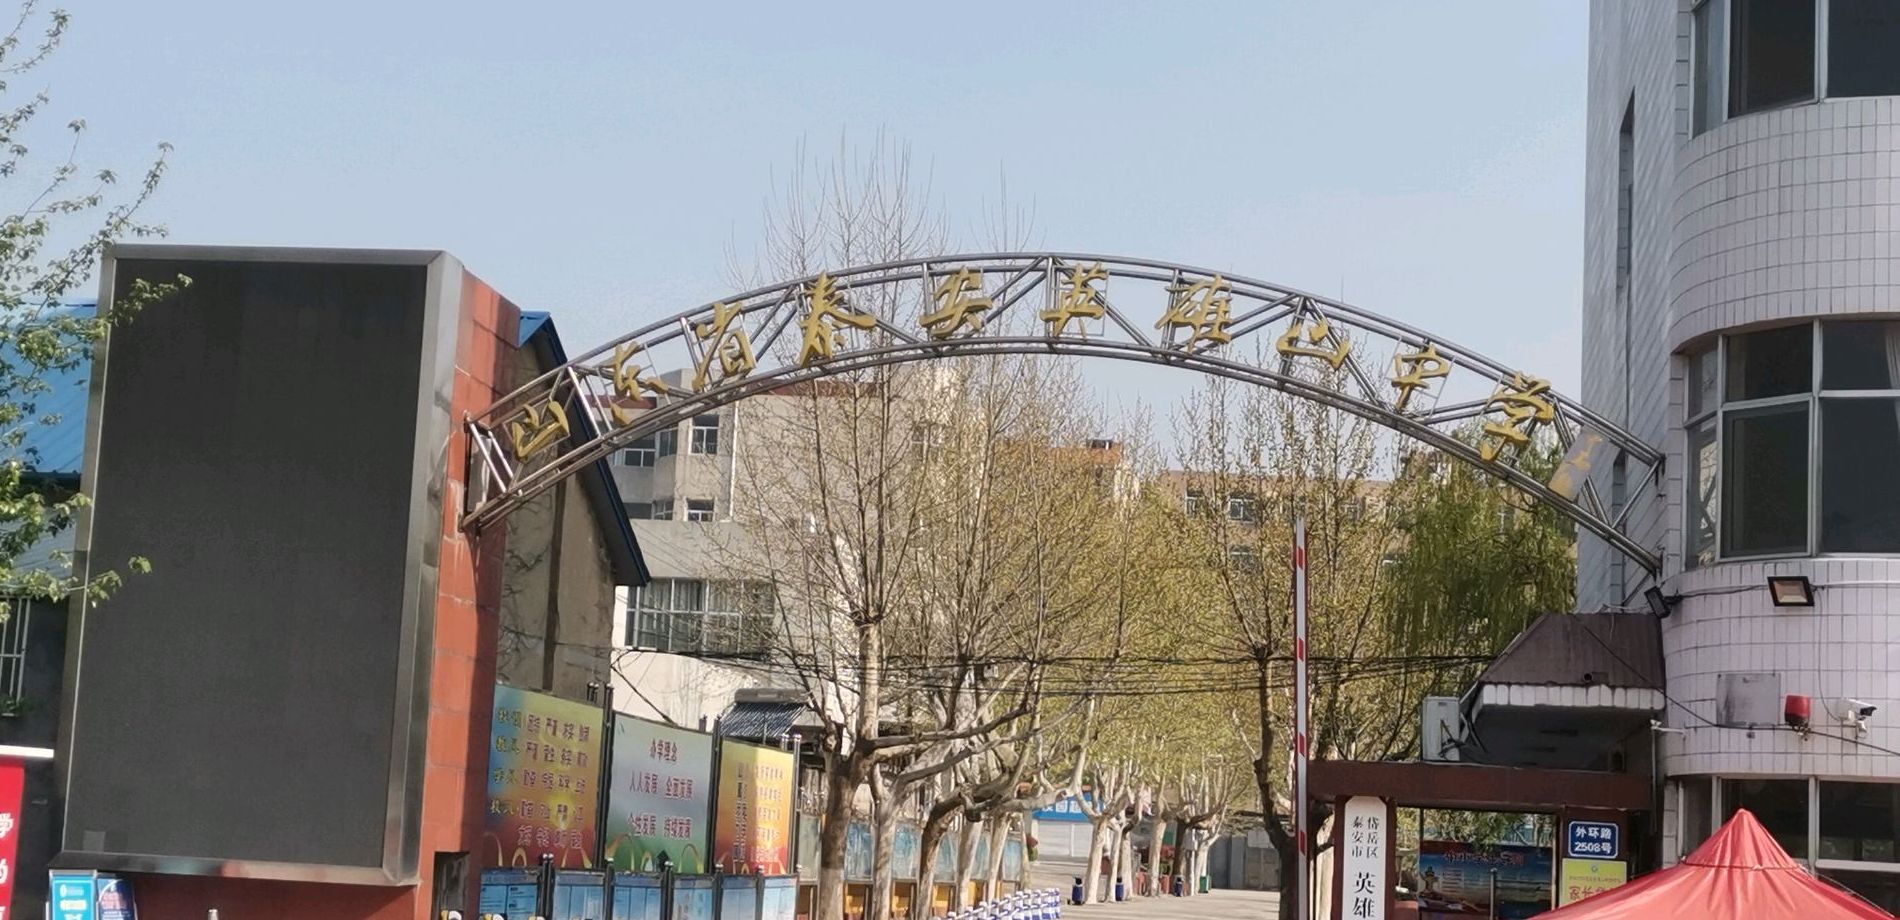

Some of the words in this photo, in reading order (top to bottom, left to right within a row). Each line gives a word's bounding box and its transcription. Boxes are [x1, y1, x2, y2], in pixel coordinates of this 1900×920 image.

[1352, 815, 1364, 858] 泰安市
[1366, 816, 1379, 858] 岱岳区
[1574, 841, 1612, 854] 2508号
[1575, 826, 1612, 840] 外环路
[1352, 872, 1376, 919] 英雄
